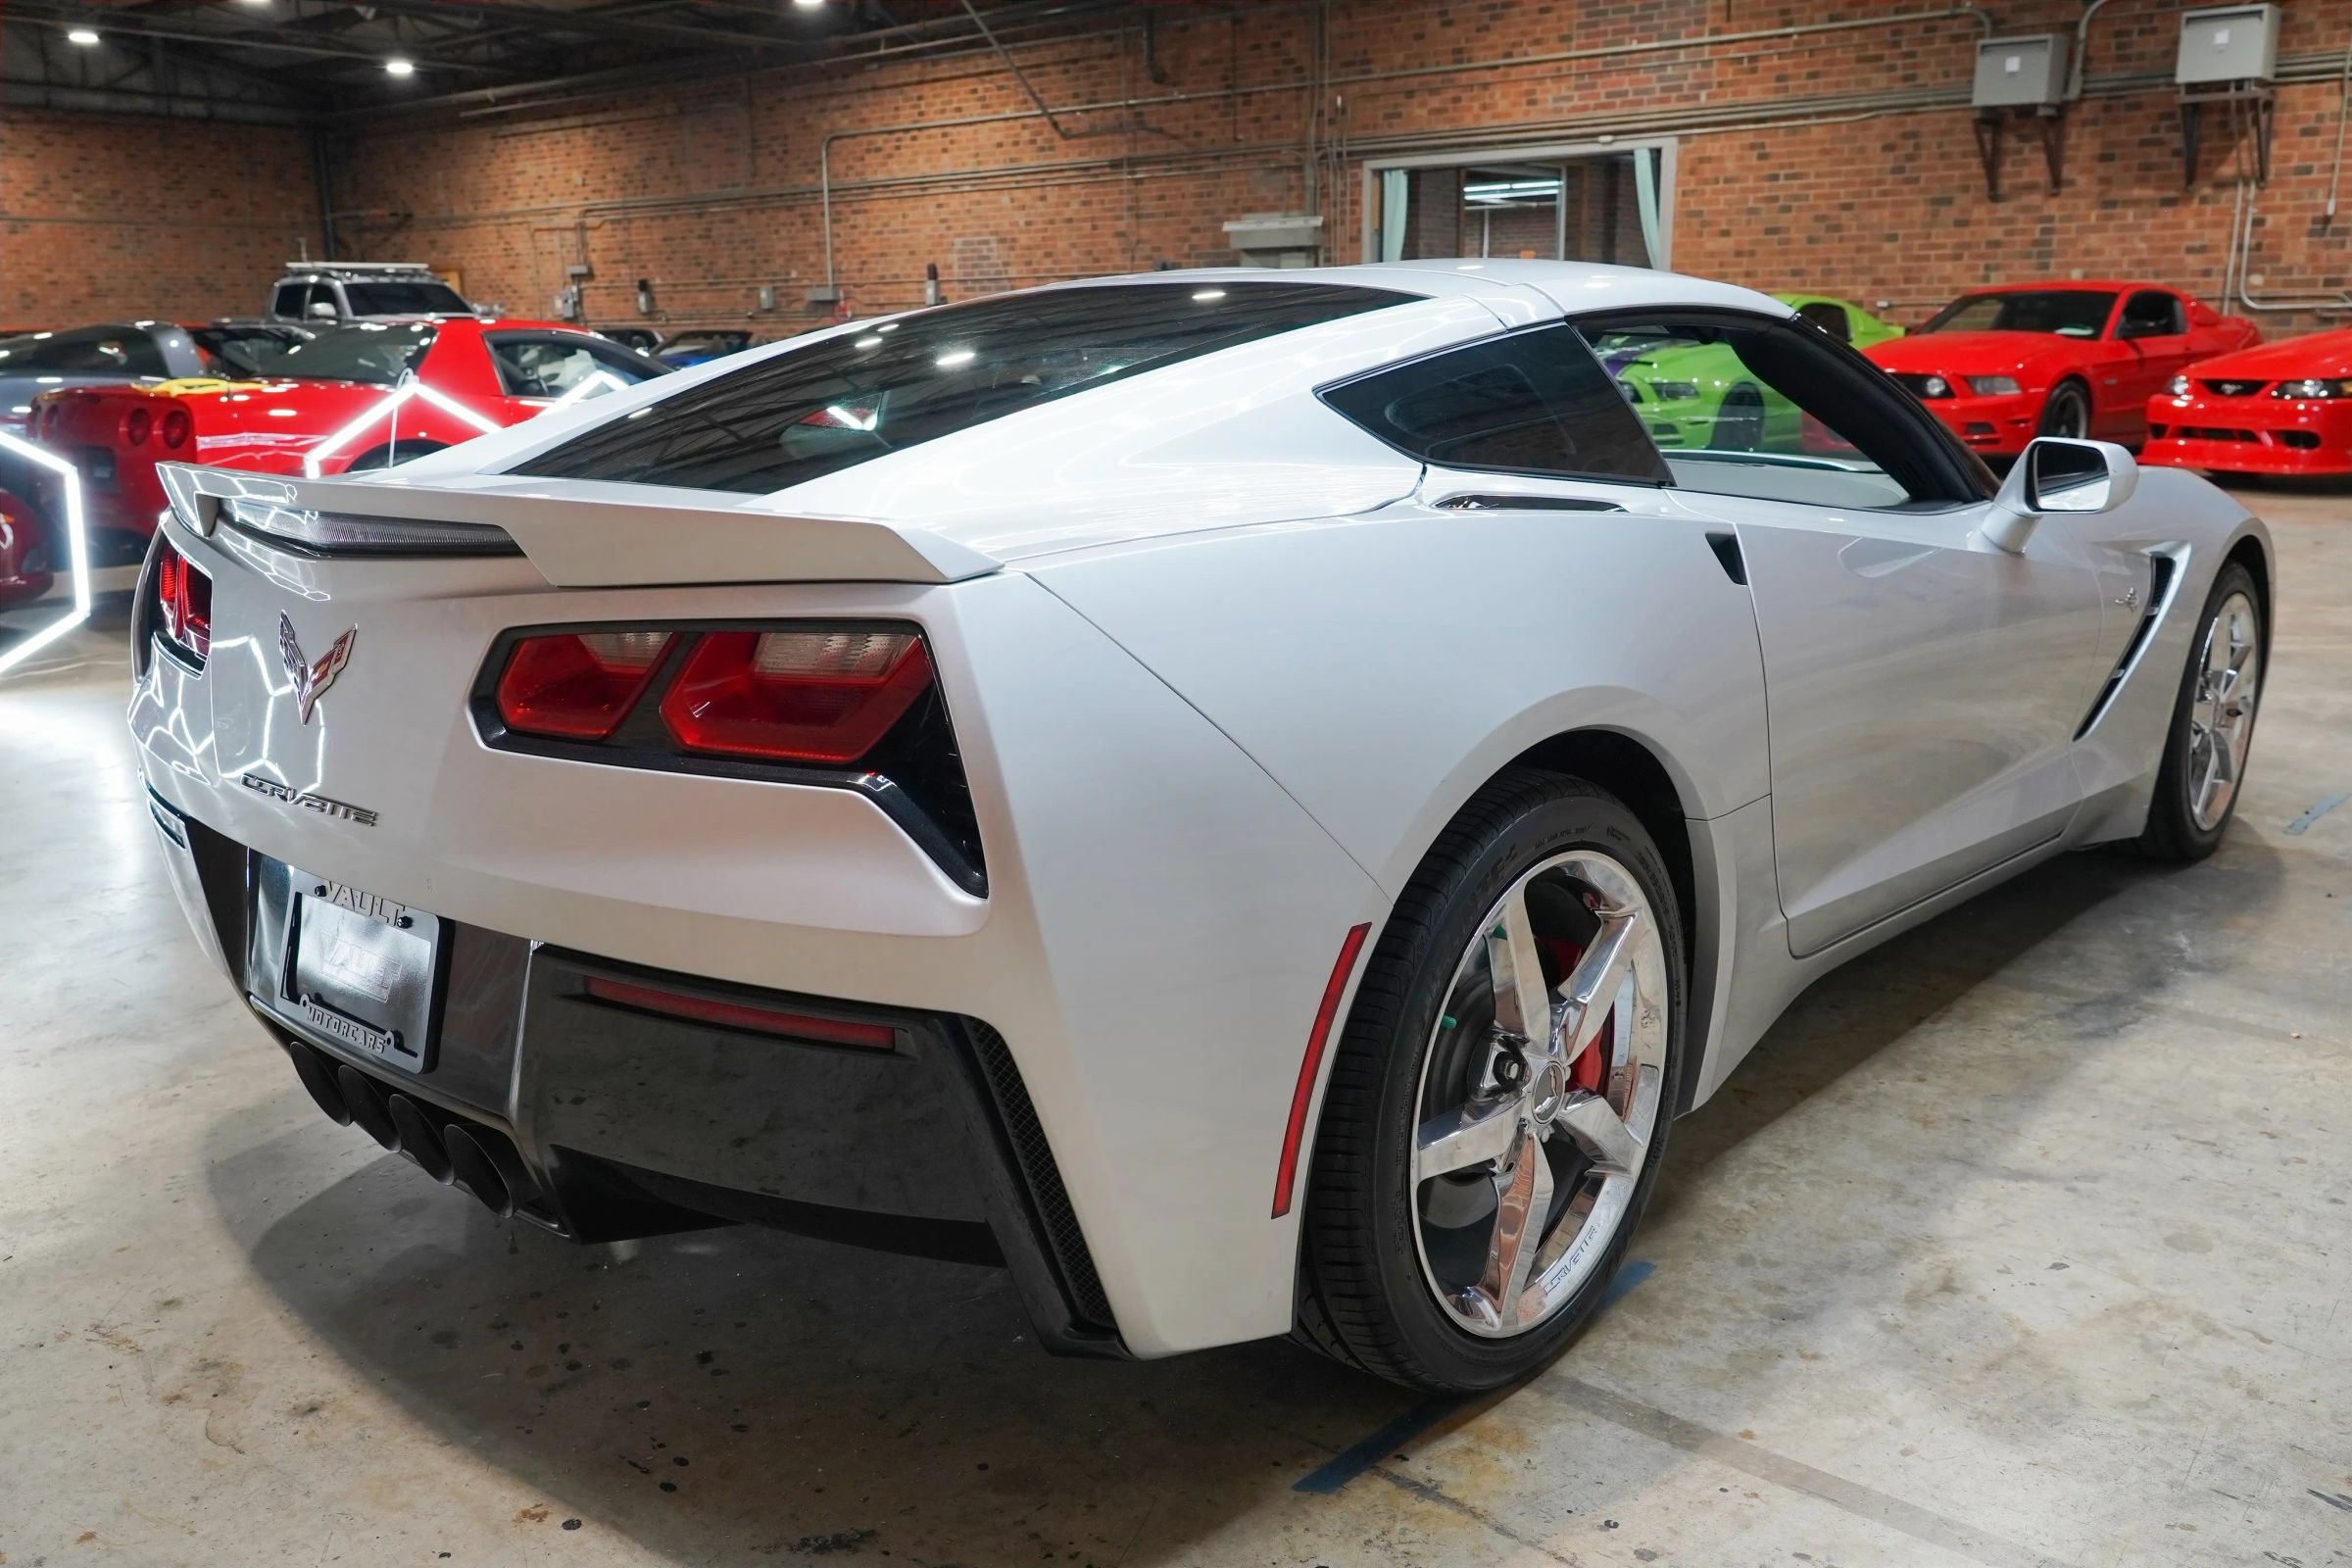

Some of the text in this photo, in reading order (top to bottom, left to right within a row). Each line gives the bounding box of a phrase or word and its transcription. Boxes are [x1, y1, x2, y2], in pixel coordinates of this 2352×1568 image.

[241, 772, 378, 826] CORVETTE
[326, 880, 406, 927] VAULT
[307, 1005, 386, 1054] MOTORCARS
[1544, 1224, 1598, 1296] CORVETTE
